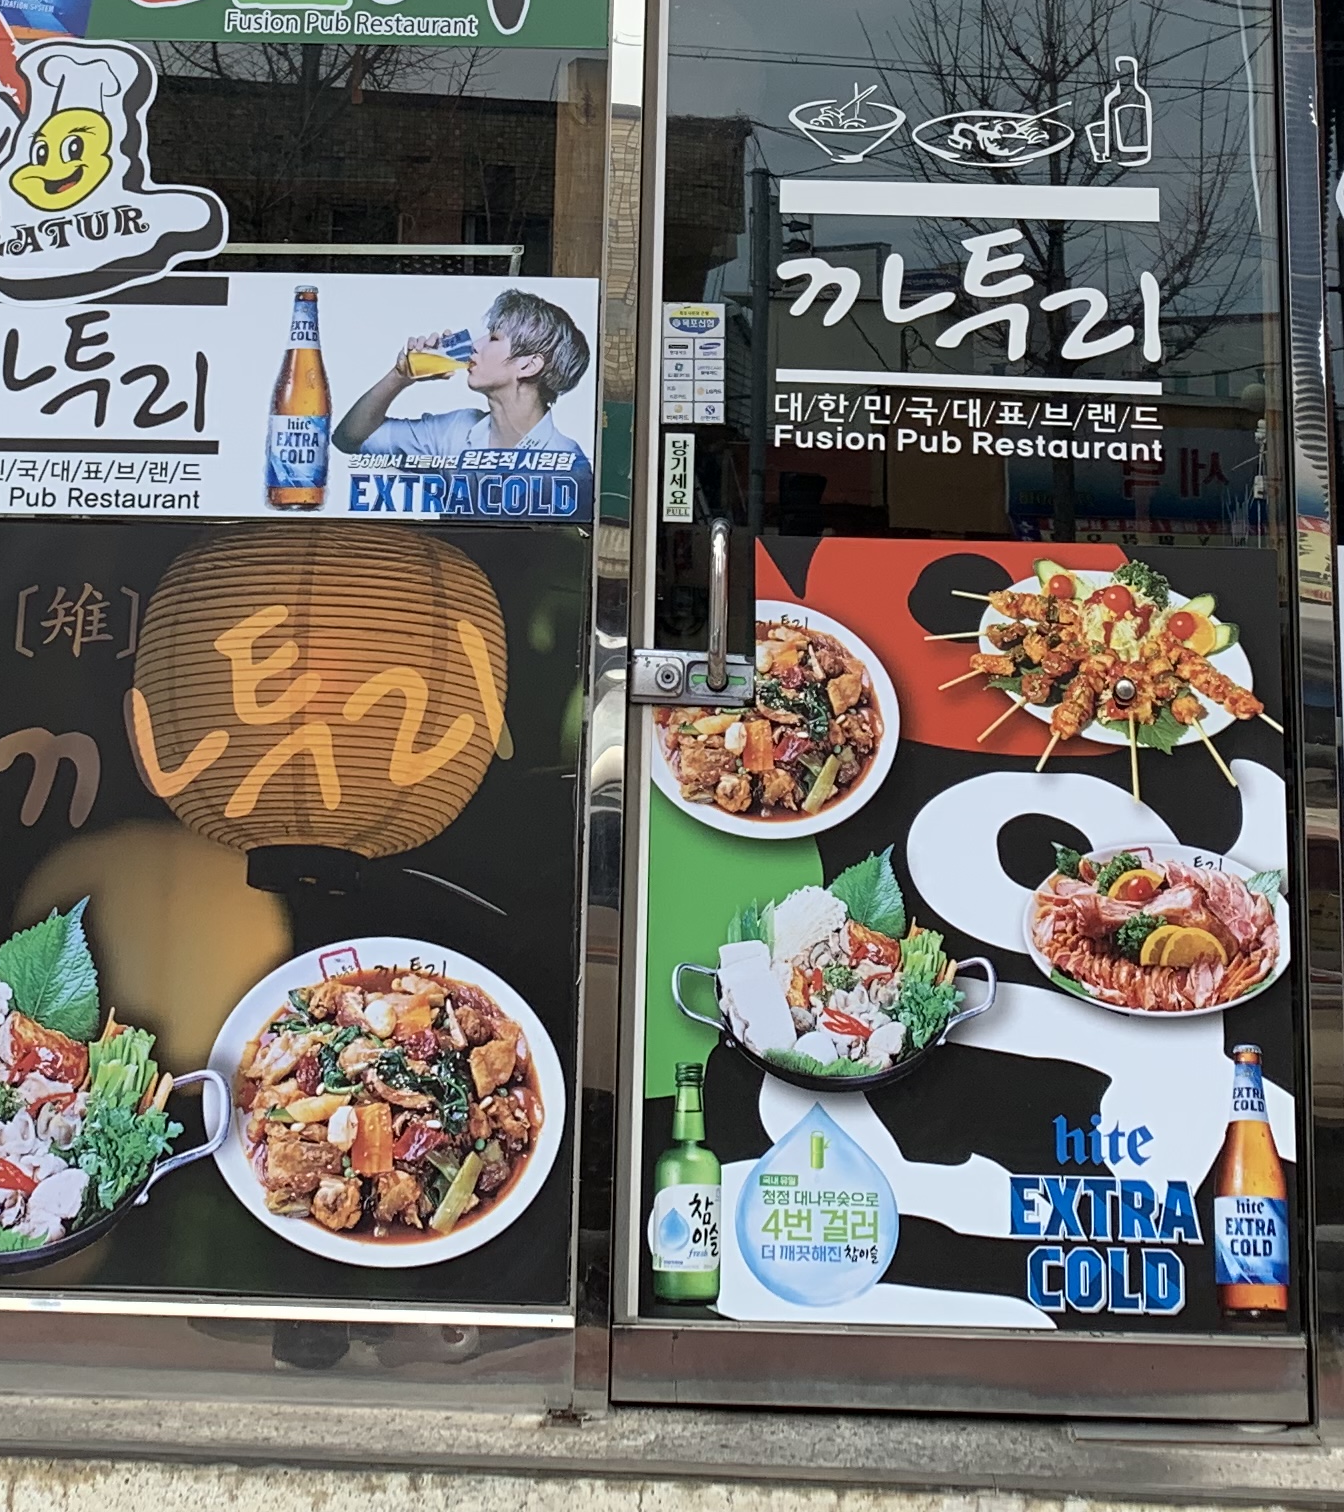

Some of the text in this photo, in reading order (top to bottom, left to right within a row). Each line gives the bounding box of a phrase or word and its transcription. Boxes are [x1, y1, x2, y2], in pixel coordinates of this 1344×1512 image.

[225, 10, 479, 37] Fusion Pub Restaurant
[776, 228, 1163, 364] 까투리
[290, 320, 319, 331] EXTRA
[290, 331, 318, 342] COLD
[287, 417, 311, 431] hite
[276, 432, 319, 448] EXTRA
[774, 425, 1164, 463] Fusion Pub Restaurant
[279, 448, 316, 464] COLD
[462, 451, 517, 470] 원초적
[518, 451, 577, 472] 시원함
[669, 439, 690, 505] 당기세요
[9, 487, 58, 507] Pub
[67, 487, 202, 510] Restaurant
[347, 473, 579, 517] EXTRA COLD
[666, 508, 690, 516] PULL
[1232, 1087, 1265, 1100] EXTRA
[1233, 1100, 1265, 1112] COLD
[1052, 1113, 1155, 1166] hite
[762, 1189, 790, 1206] 청정
[1236, 1198, 1265, 1215] hite
[1008, 1175, 1204, 1245] EXTRA
[761, 1208, 879, 1243] 4번 걸러
[1225, 1217, 1276, 1237] EXTRA
[761, 1244, 879, 1264] 더 깨끗해진 참이슬
[1230, 1239, 1273, 1257] COLD
[1027, 1245, 1187, 1316] COLD
